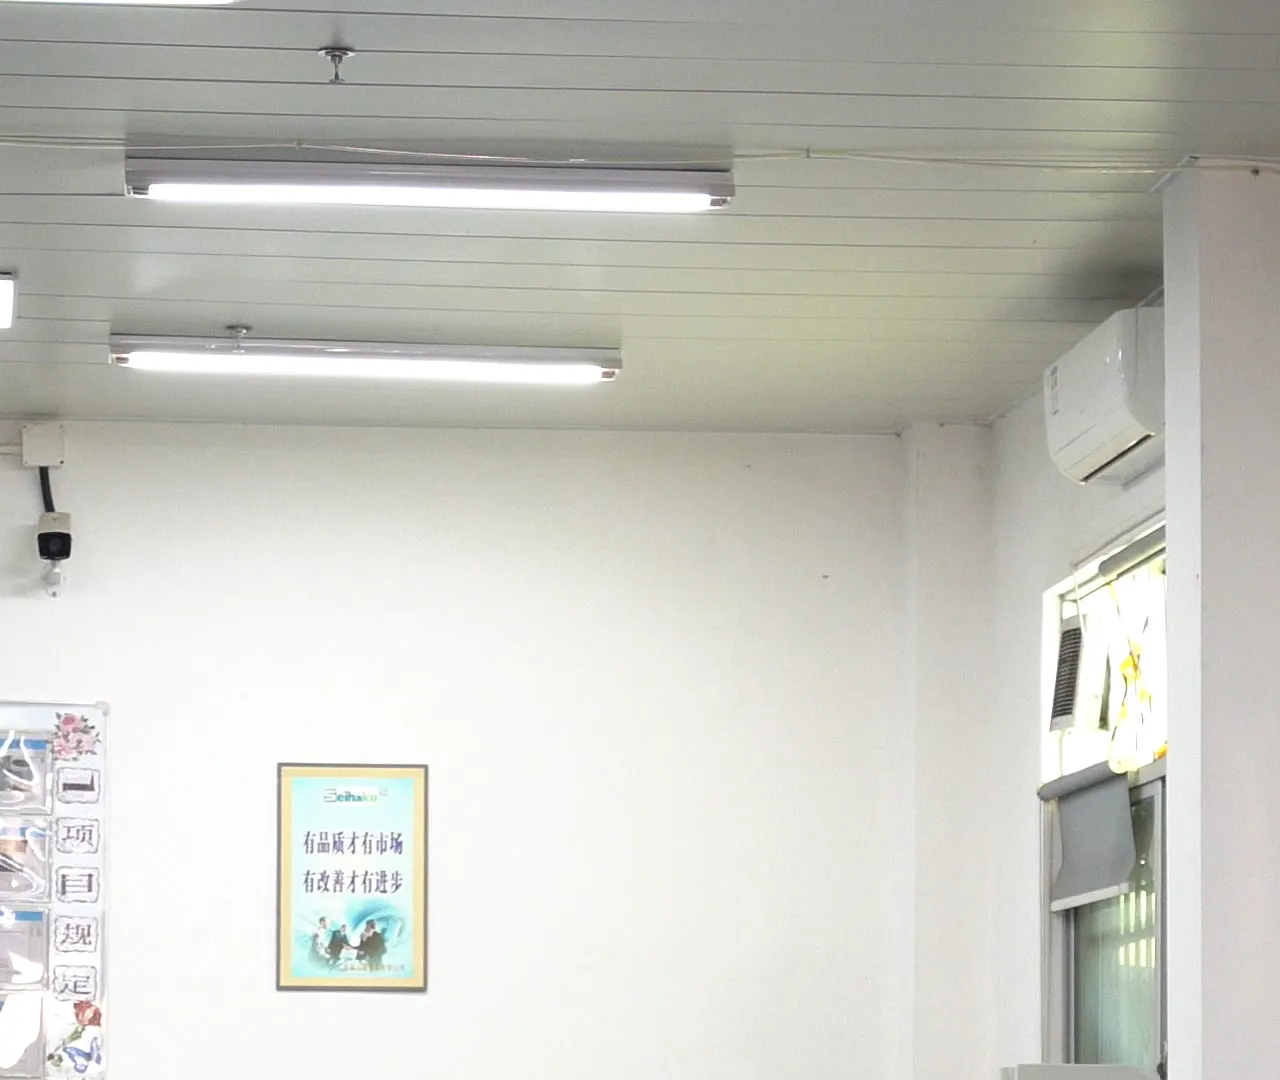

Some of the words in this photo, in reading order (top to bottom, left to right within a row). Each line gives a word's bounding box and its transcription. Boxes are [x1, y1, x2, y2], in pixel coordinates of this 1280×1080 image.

[303, 831, 404, 855] 有品质才有市场
[302, 870, 404, 894] 有改善才有进步
